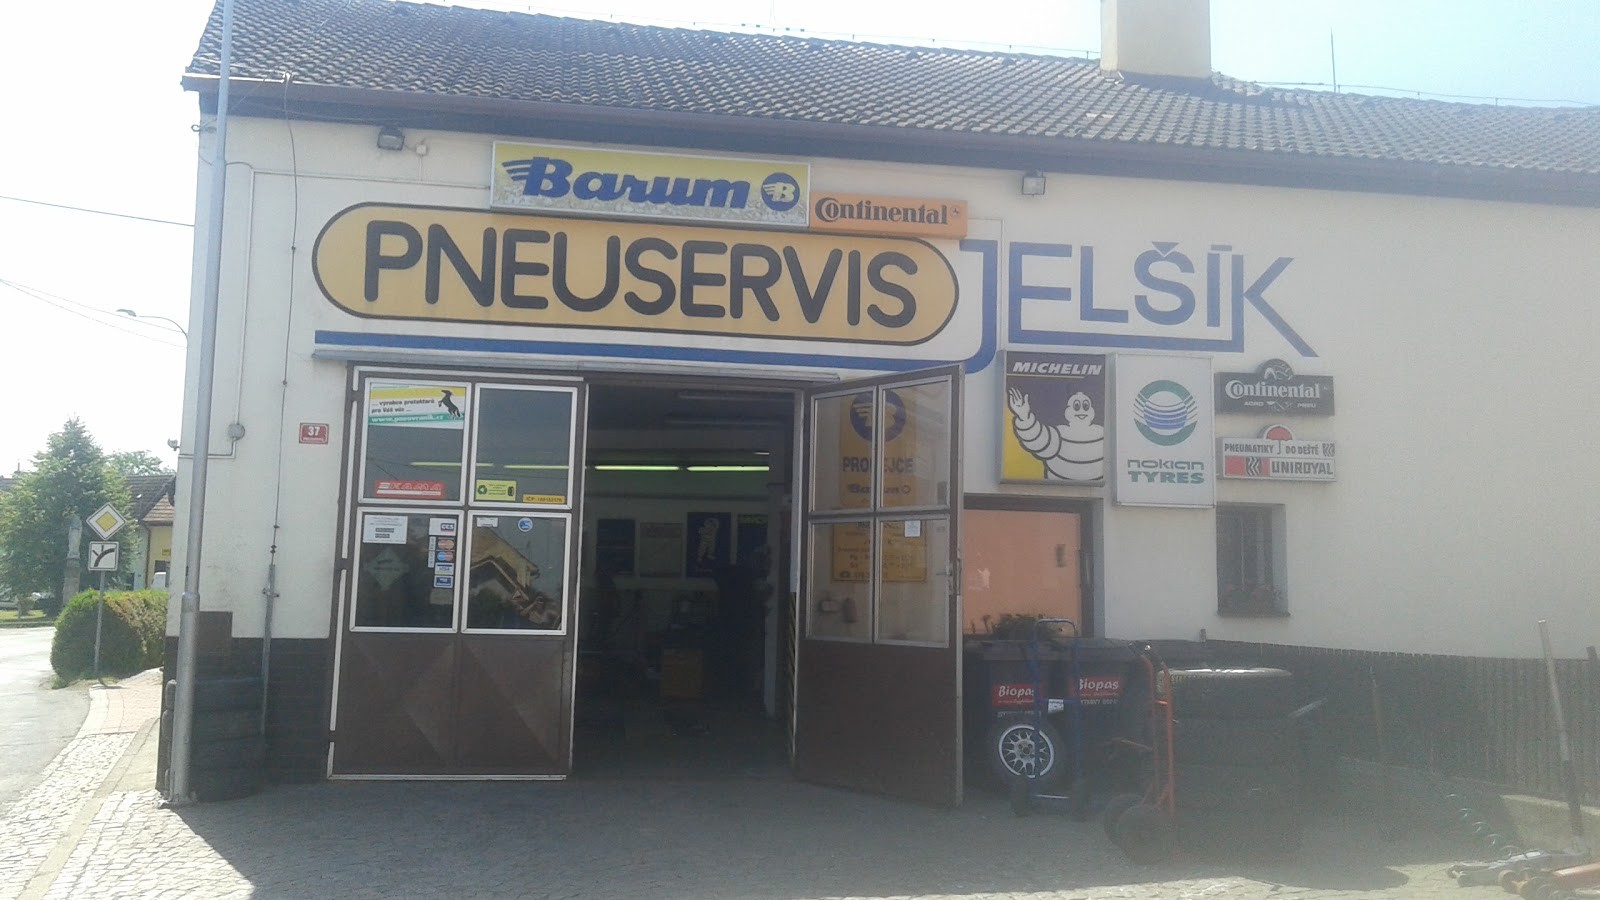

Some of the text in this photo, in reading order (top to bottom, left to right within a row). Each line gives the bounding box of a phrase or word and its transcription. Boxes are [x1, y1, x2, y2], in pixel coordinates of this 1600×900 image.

[520, 156, 750, 210] Barum
[815, 197, 948, 225] Continental
[363, 220, 919, 329] PNEUSERVIS
[959, 239, 1320, 374] JELŠÍK
[1012, 361, 1103, 376] MICHELIN
[1225, 380, 1321, 399] Continental
[308, 426, 320, 437] 37
[1224, 443, 1275, 454] PNEUMATIKY
[1285, 445, 1297, 455] DO
[1127, 458, 1205, 471] nokian
[1271, 461, 1334, 475] UNIROYAL
[1127, 471, 1205, 485] TYRES
